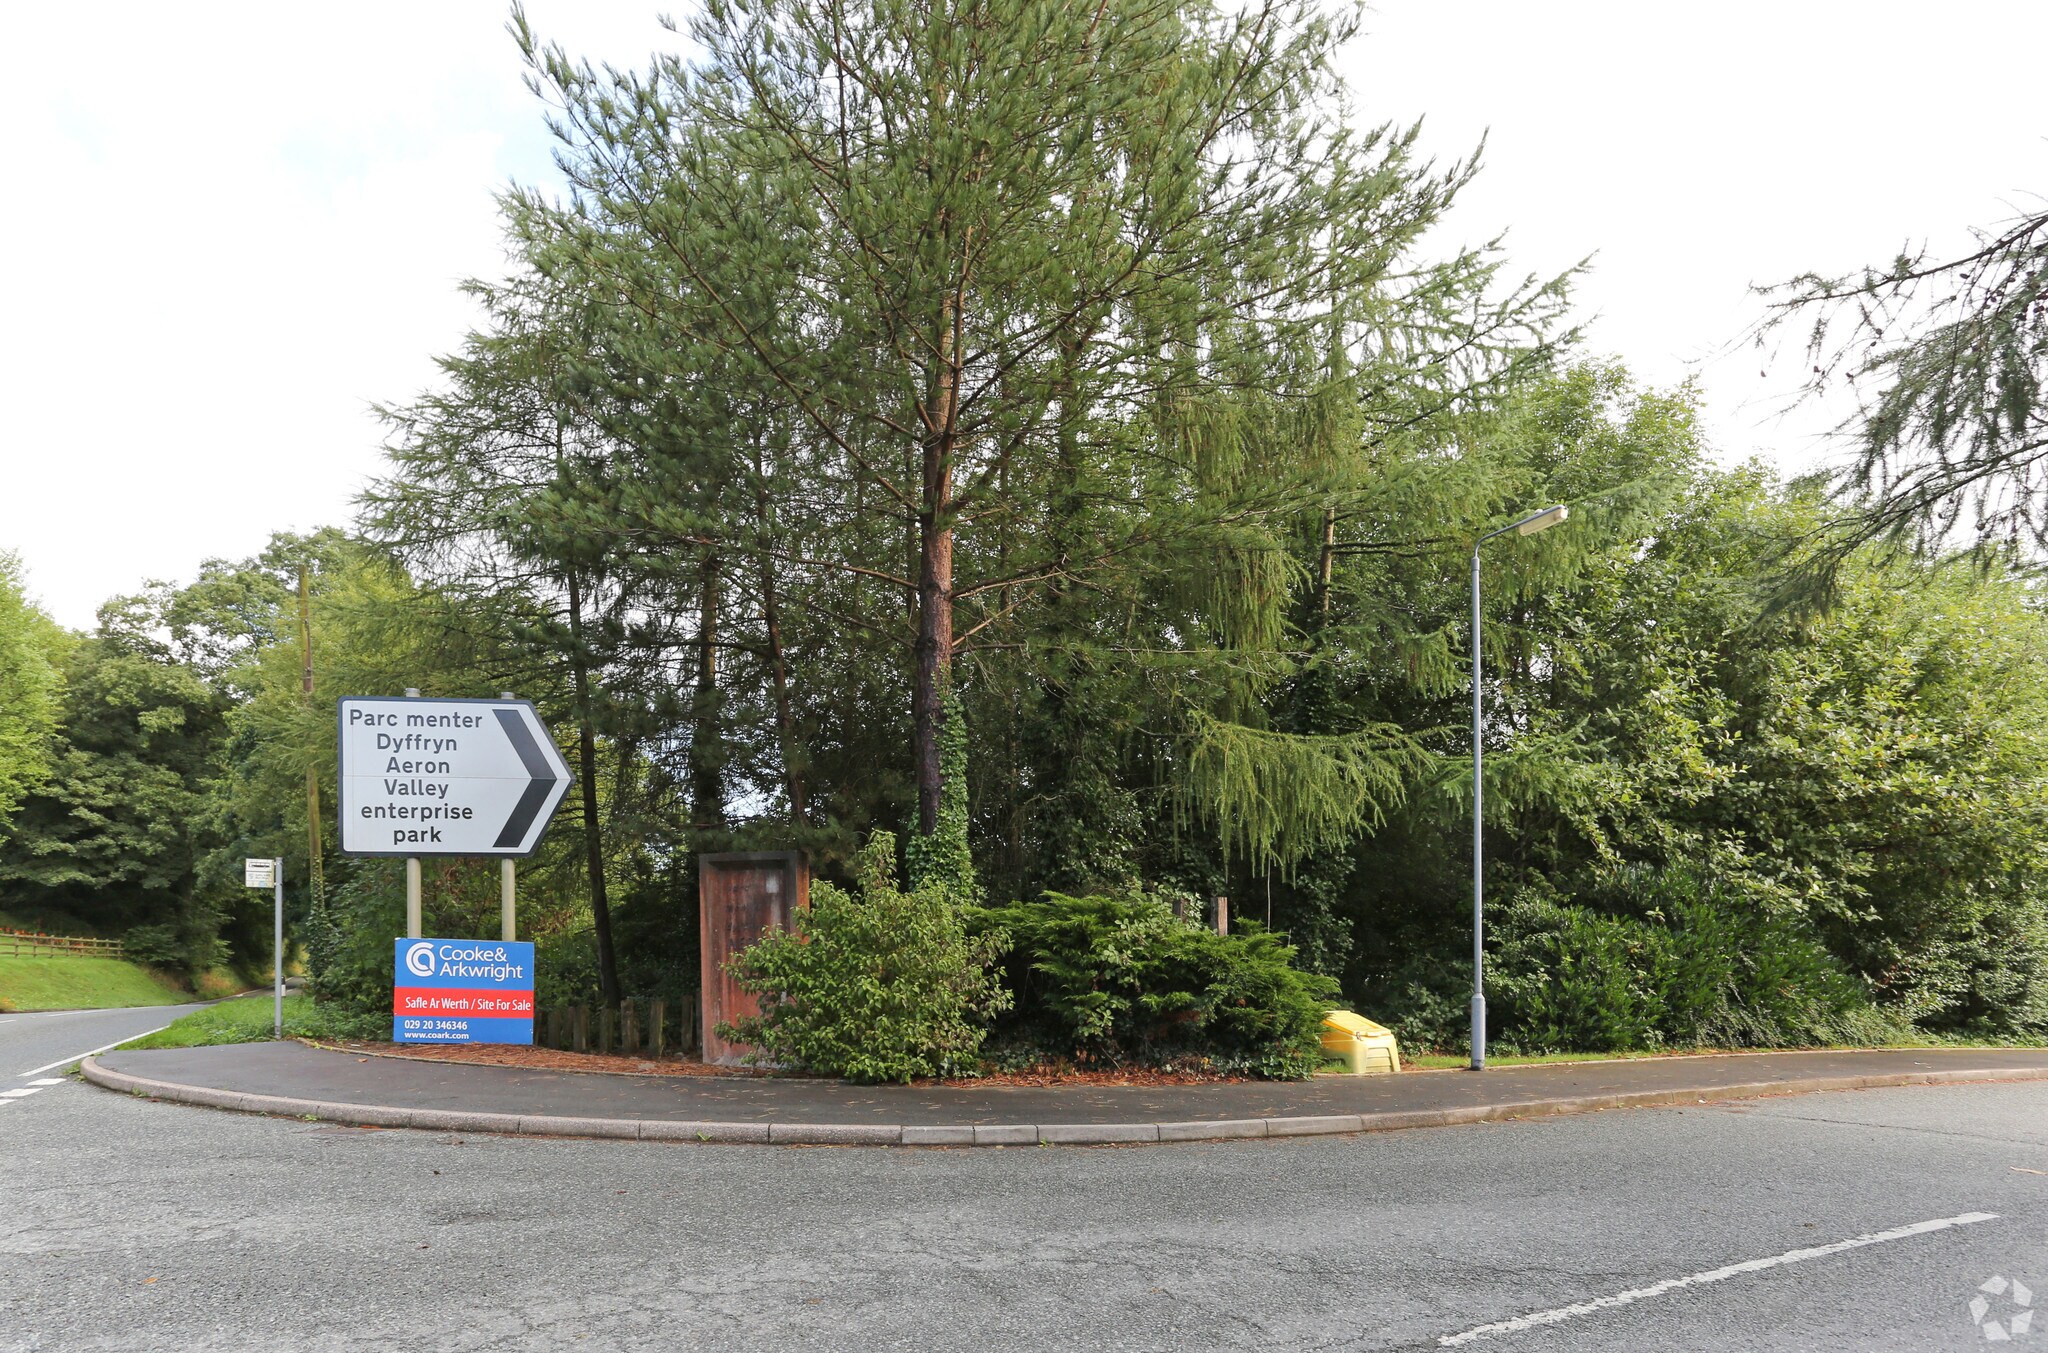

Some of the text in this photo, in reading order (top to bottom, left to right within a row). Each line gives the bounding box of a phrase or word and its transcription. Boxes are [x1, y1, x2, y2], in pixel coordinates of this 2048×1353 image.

[350, 709, 483, 728] Parc menter
[377, 733, 457, 753] Dyffryn
[386, 757, 450, 773] Aeron
[384, 779, 449, 799] Valley
[361, 802, 473, 822] enterprise
[394, 826, 442, 845] park
[439, 945, 507, 962] Cooke&
[439, 962, 523, 981] Arkwright
[406, 997, 428, 1009] Safle
[430, 998, 440, 1009] Ar
[441, 998, 468, 1009] Werth
[477, 999, 494, 1010] Site
[496, 999, 510, 1010] For
[512, 1000, 531, 1011] Sale
[404, 1020, 467, 1030] 029 20 346346
